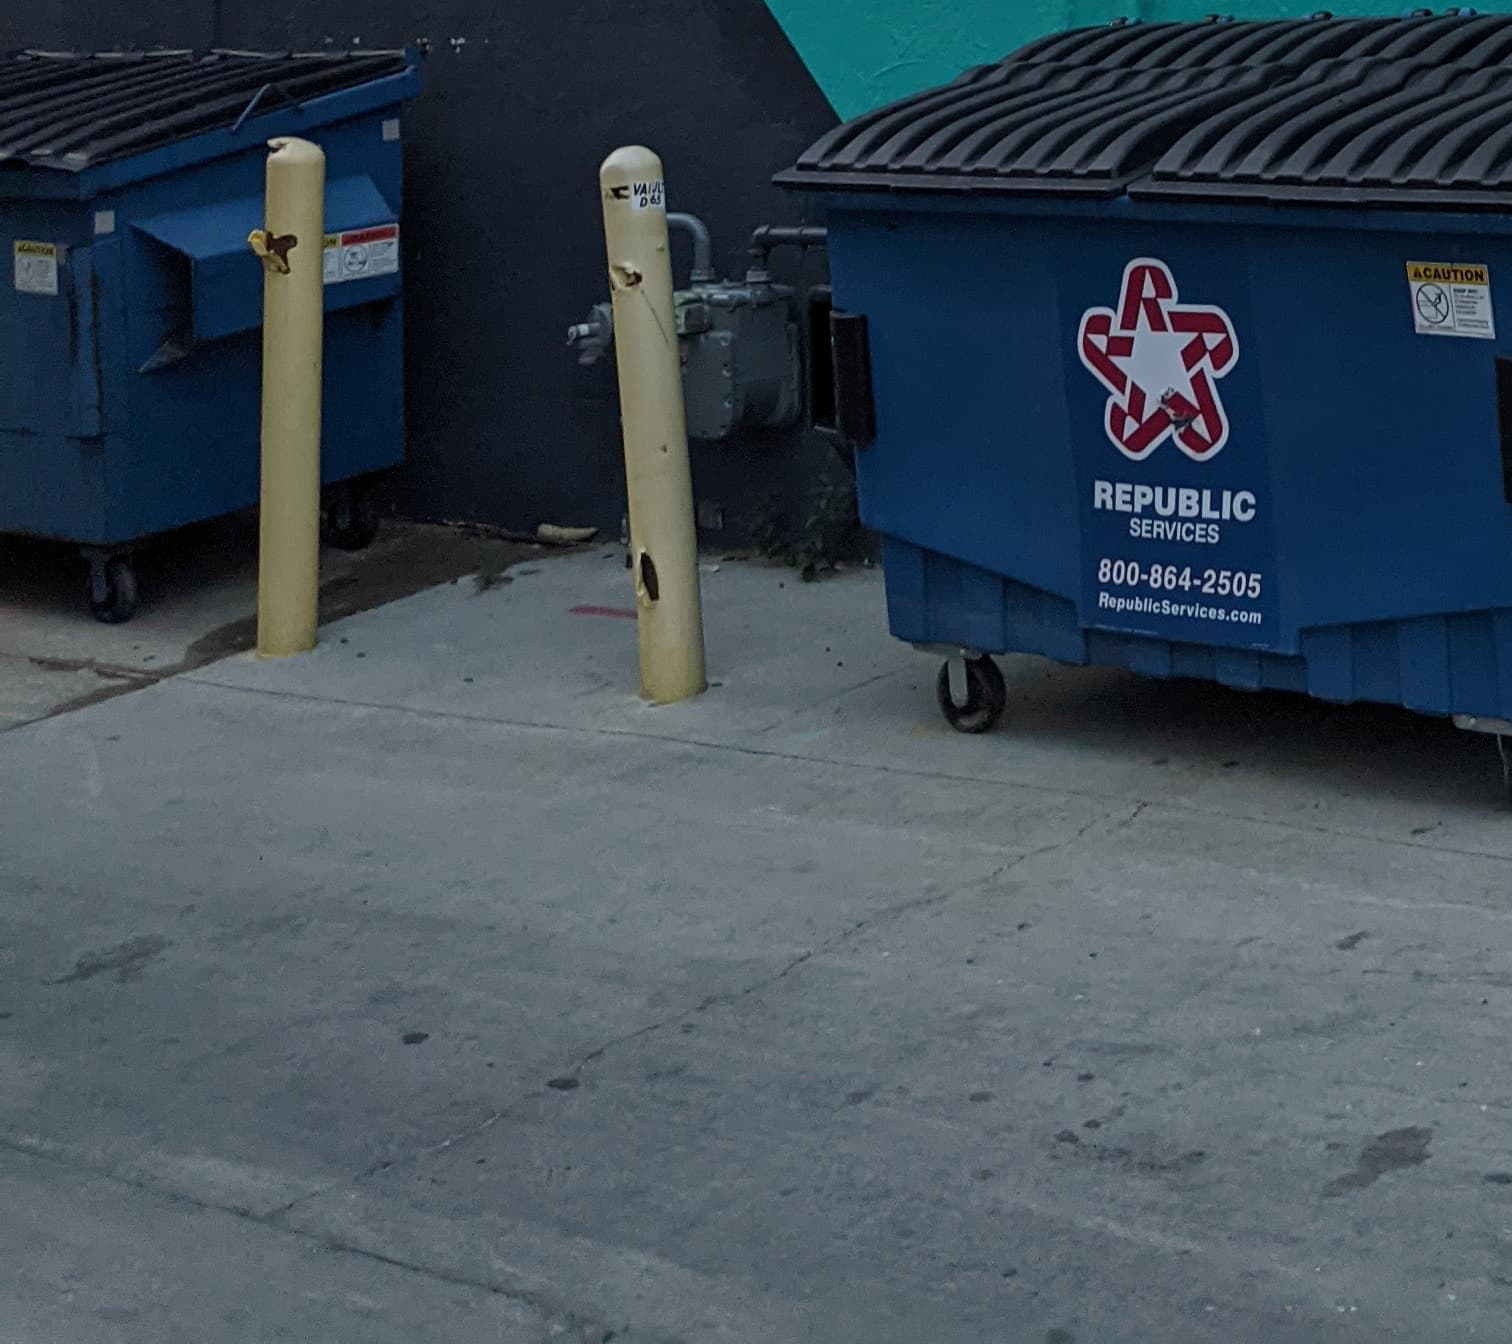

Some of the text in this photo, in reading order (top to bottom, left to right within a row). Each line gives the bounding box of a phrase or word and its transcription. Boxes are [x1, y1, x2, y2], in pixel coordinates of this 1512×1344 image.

[639, 196, 649, 208] D
[1422, 267, 1485, 282] CAUTION
[1094, 480, 1257, 521] REPUBLIC
[1129, 517, 1220, 544] SERVICES
[1098, 558, 1262, 599] 800-864-2505
[1098, 591, 1262, 624] RepublicServices.com
